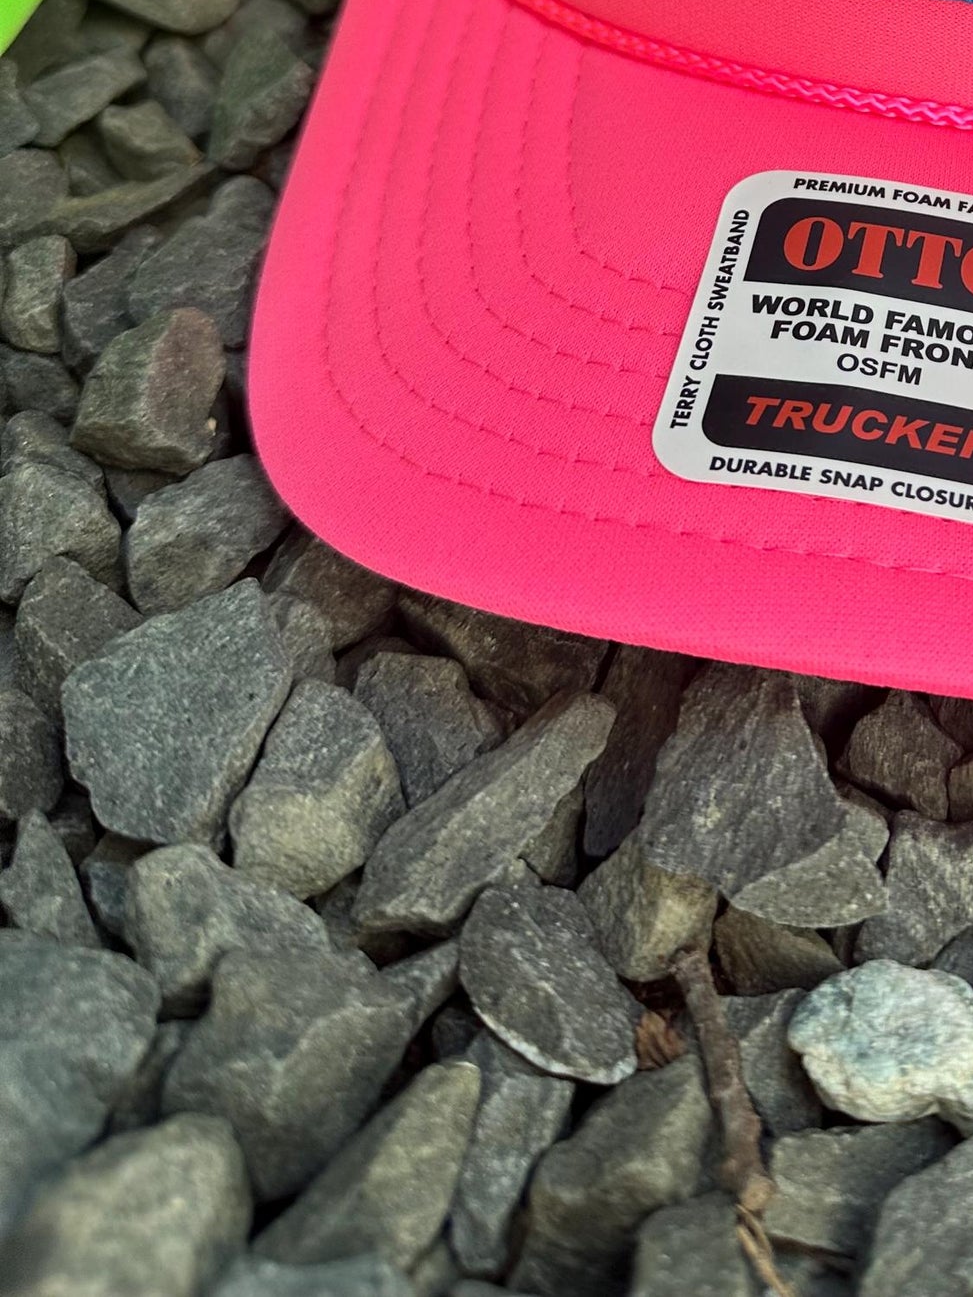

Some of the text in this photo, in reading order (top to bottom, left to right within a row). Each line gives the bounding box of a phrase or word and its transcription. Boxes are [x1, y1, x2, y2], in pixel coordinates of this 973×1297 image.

[793, 178, 886, 199] PREMIUM
[893, 189, 951, 210] FOAM
[670, 209, 749, 429] TERRY CLOTH SWEATBAND
[751, 294, 874, 325] WORLD
[770, 320, 869, 348] FOAM
[836, 353, 922, 386] OSFM
[709, 456, 812, 481] DURABLE
[819, 469, 884, 491] SNAP
